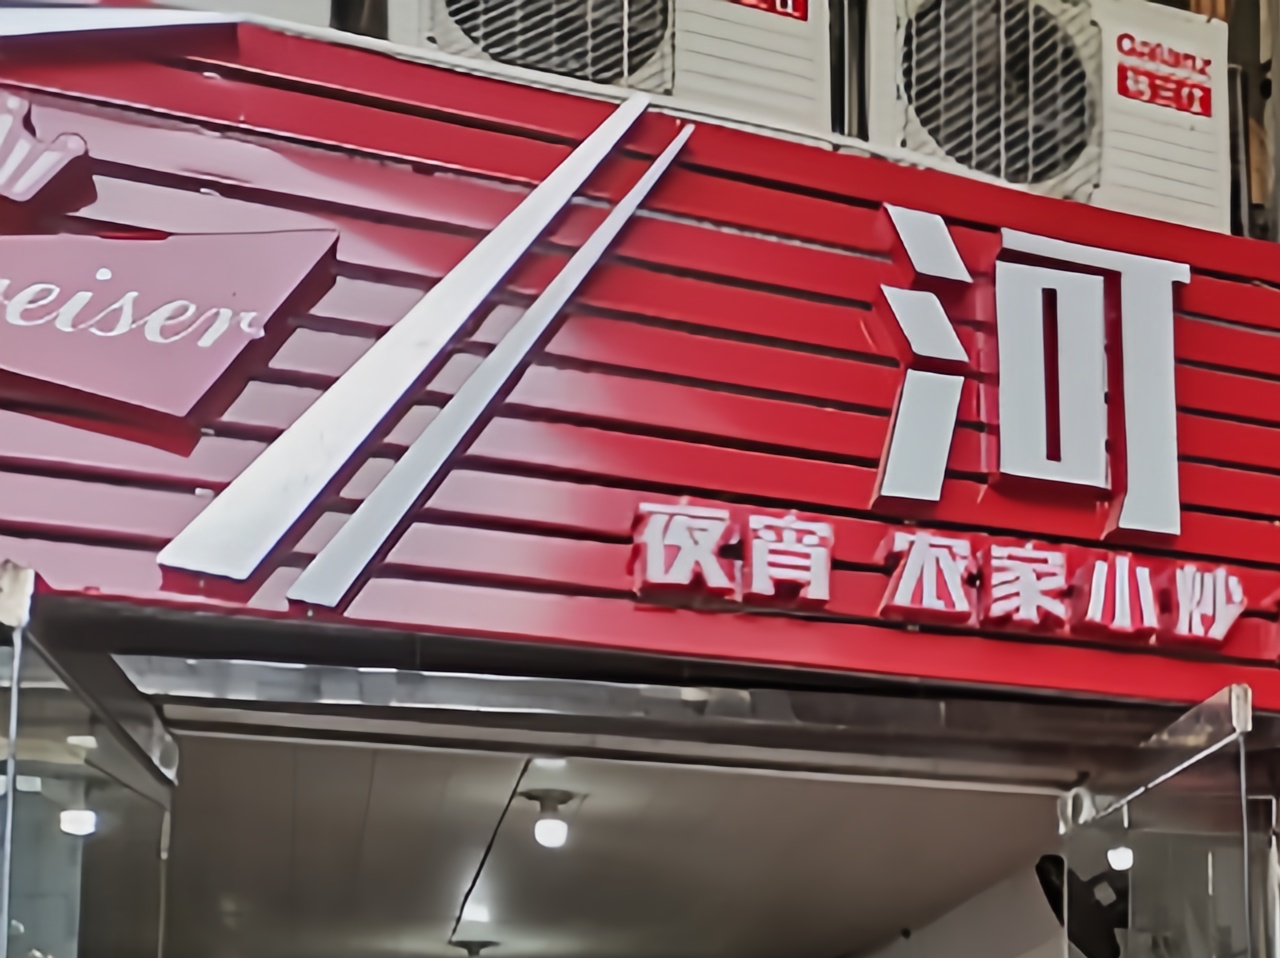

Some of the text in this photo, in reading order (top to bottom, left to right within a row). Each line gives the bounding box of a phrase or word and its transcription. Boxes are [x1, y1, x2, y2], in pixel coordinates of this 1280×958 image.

[0, 267, 265, 347] eiser
[638, 495, 833, 601] 夜宵
[891, 531, 1248, 642] 农家小炒
